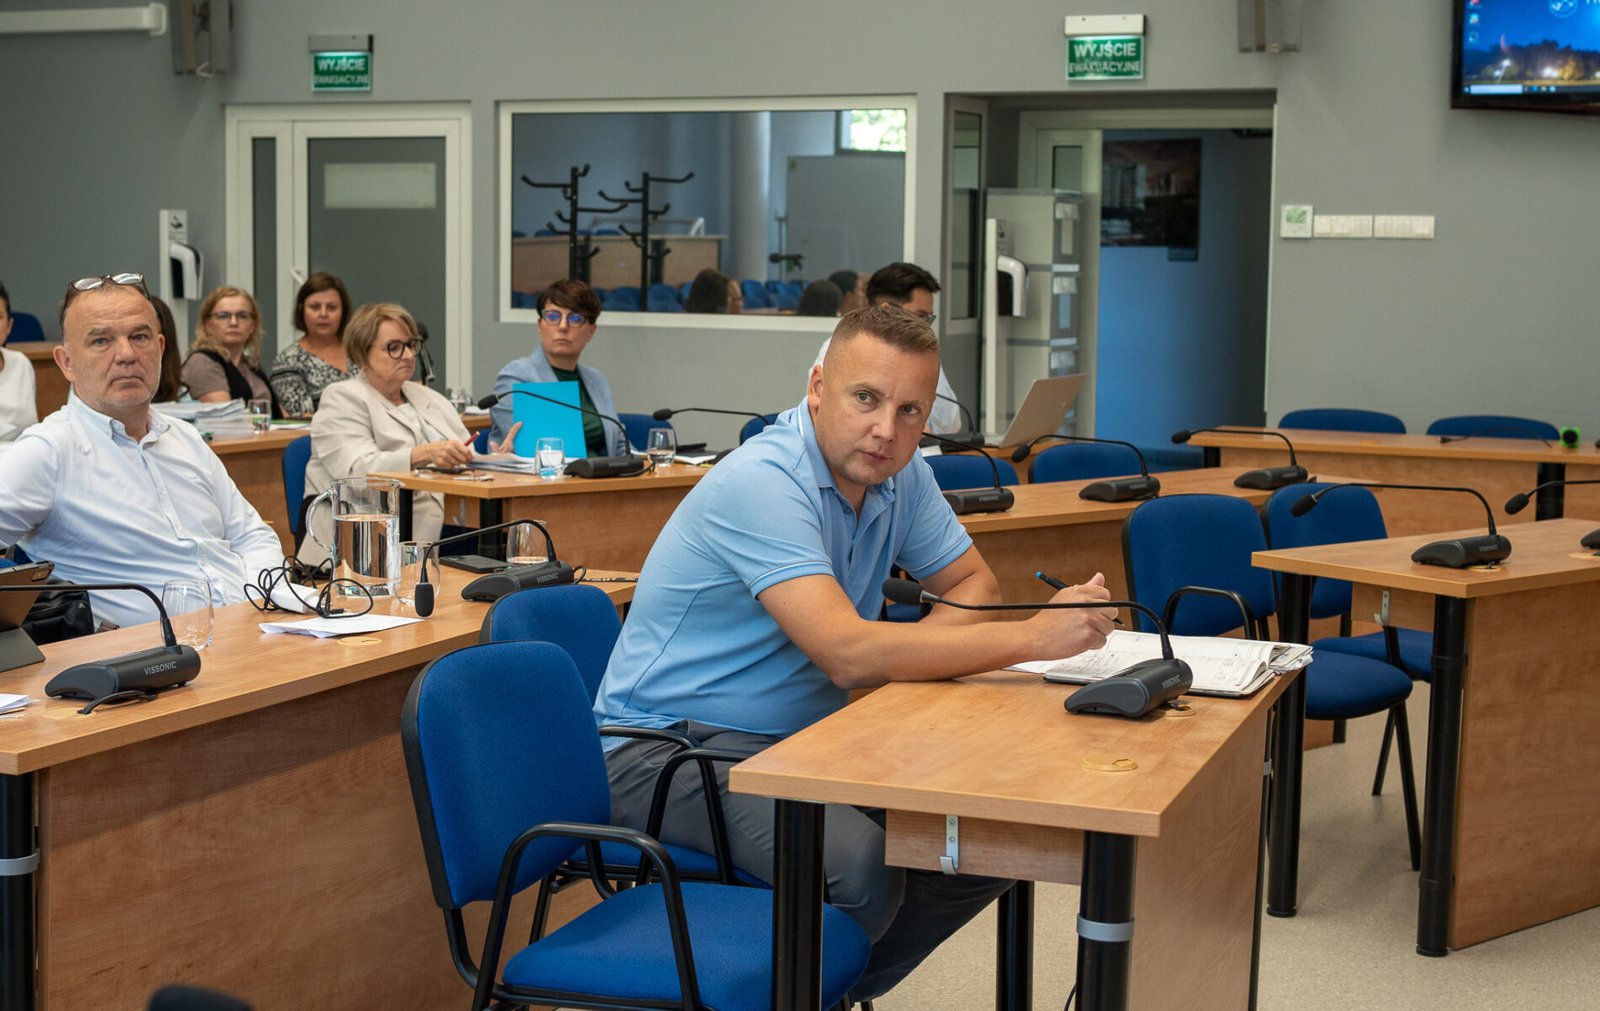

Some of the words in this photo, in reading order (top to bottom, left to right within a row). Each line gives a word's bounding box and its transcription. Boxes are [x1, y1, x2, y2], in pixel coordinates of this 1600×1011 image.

[1074, 41, 1137, 58] WYJŚCIE
[318, 57, 366, 71] WYJŚCIE
[144, 661, 177, 676] VISSONIC
